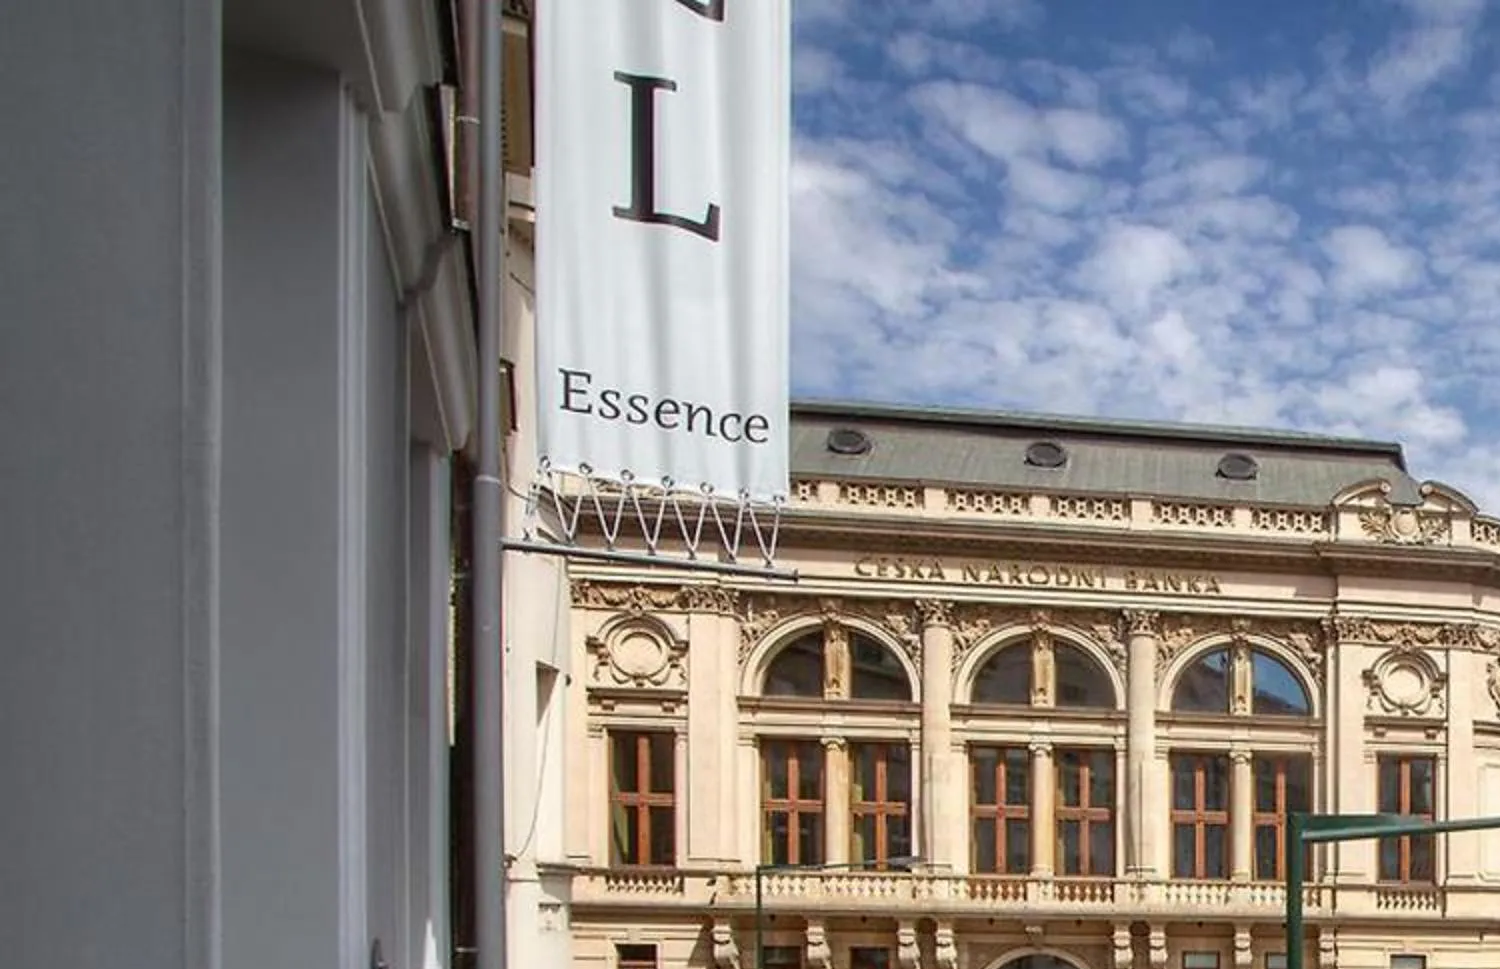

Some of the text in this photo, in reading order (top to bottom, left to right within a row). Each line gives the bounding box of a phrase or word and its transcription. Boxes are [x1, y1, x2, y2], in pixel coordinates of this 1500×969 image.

[612, 0, 724, 242] L
[558, 367, 769, 444] Essence
[1124, 569, 1221, 594] BANKA
